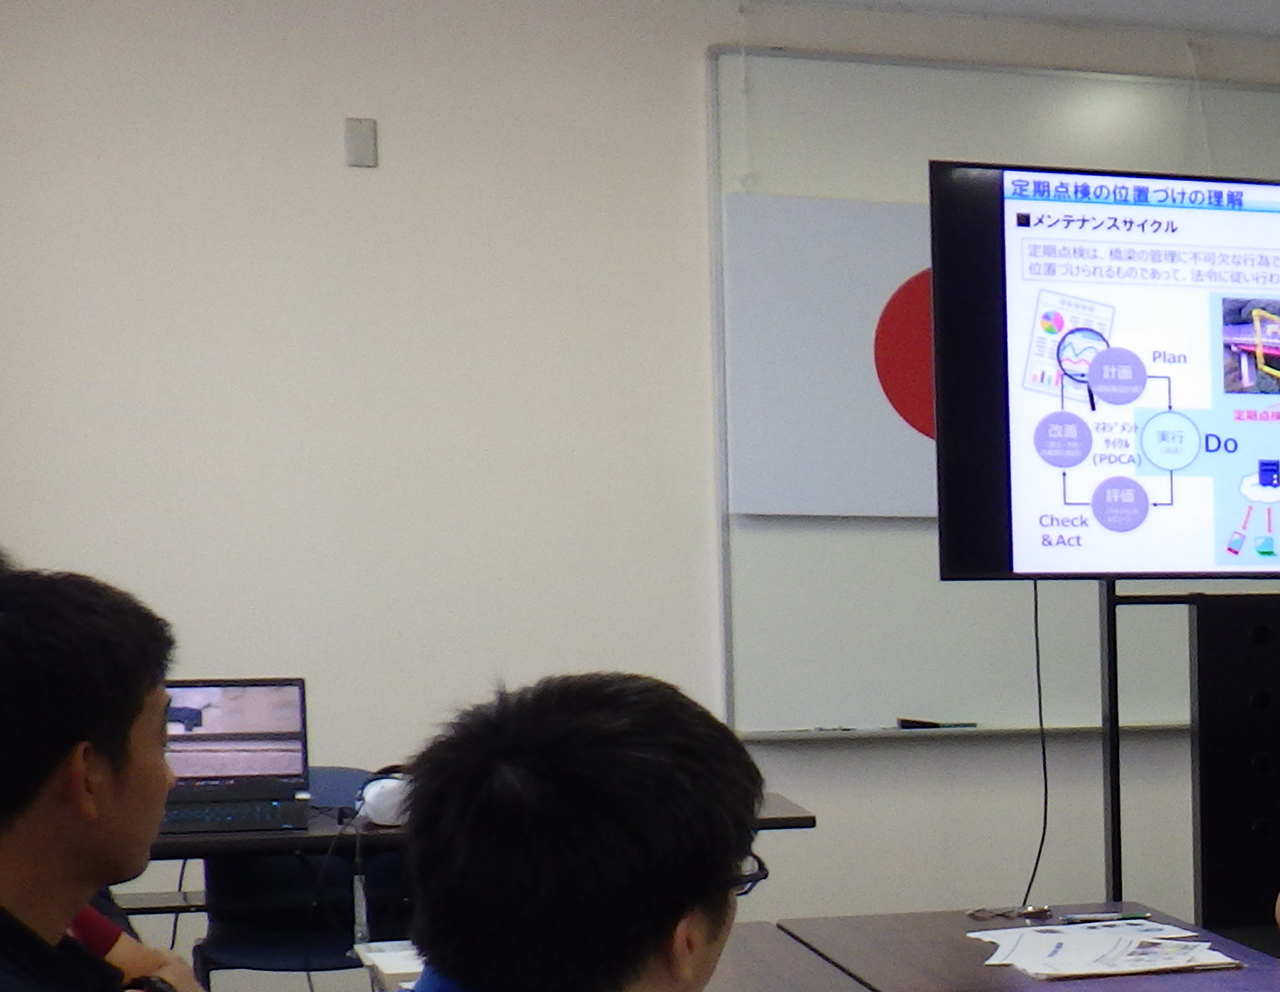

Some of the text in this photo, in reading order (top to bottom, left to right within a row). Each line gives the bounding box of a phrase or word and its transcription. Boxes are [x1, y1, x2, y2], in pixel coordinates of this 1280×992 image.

[1011, 178, 1245, 209] 定期点検の位置づけの理解
[1152, 350, 1188, 365] Plan
[1204, 433, 1239, 454] Do
[1092, 453, 1142, 467] (PDCA)
[1038, 514, 1089, 528] Check
